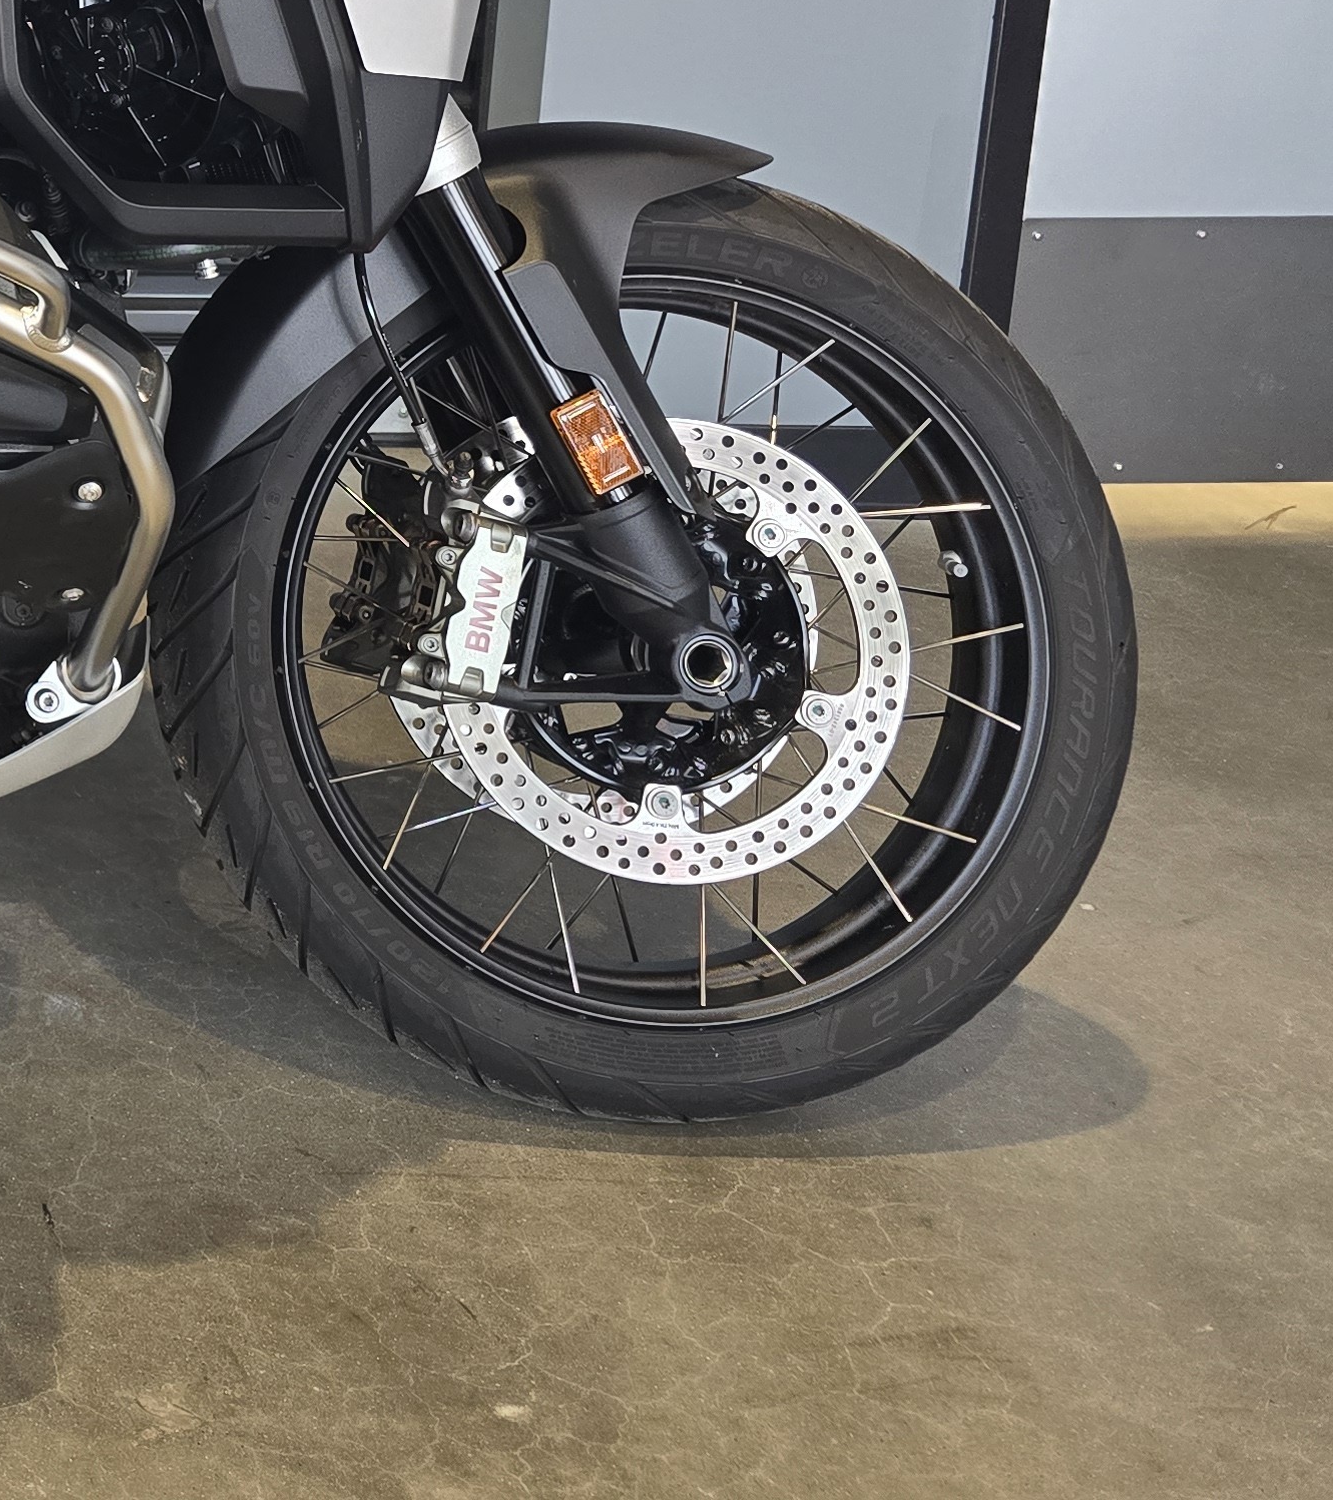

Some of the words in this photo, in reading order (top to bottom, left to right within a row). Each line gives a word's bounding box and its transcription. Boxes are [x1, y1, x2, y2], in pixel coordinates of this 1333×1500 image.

[464, 566, 505, 654] BMW
[1027, 571, 1100, 874] TOURANCE
[917, 884, 1031, 1005] NEXT
[870, 1002, 897, 1028] 2
